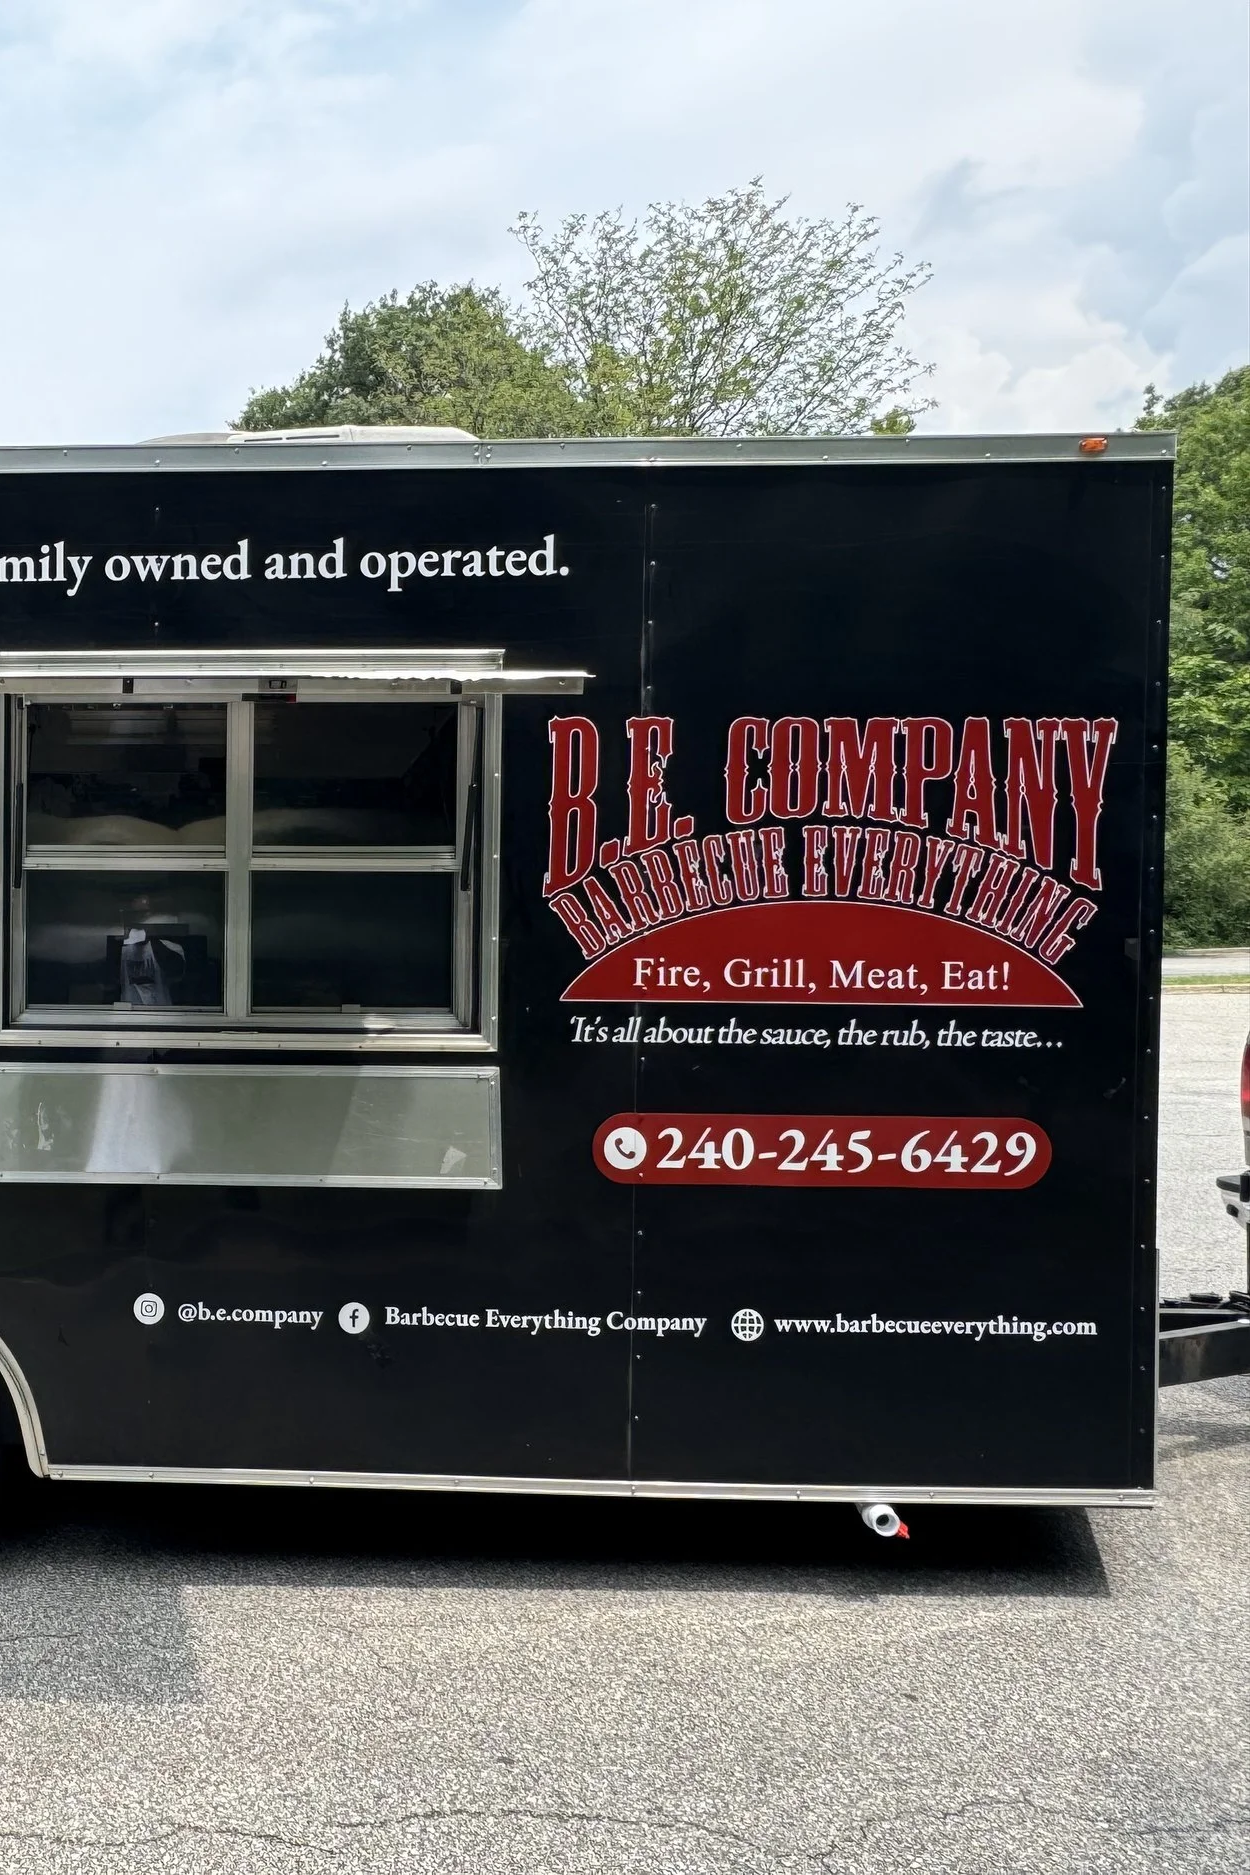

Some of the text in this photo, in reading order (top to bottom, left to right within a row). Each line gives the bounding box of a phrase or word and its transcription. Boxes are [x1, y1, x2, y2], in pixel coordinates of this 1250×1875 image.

[105, 539, 251, 581] owned
[265, 537, 347, 579] and
[360, 534, 569, 591] operated.
[543, 716, 1118, 897] B.E. COMPANY
[549, 826, 1098, 965] BARBECUE EVERYTHING
[633, 957, 1010, 995] Fire, Grill, Meat, Eat!
[612, 1016, 641, 1043] all
[643, 1016, 715, 1044] about
[717, 1017, 757, 1044] the
[760, 1027, 831, 1049] sauce,
[837, 1019, 878, 1046] the
[880, 1019, 930, 1049] rub,
[937, 1020, 978, 1047] the
[656, 1127, 1036, 1176] 240-245-6429
[178, 1302, 323, 1330] @b.e.company
[385, 1307, 707, 1338] Barbecue Everything Company
[774, 1313, 1098, 1342] www.barbecueeverything.com
